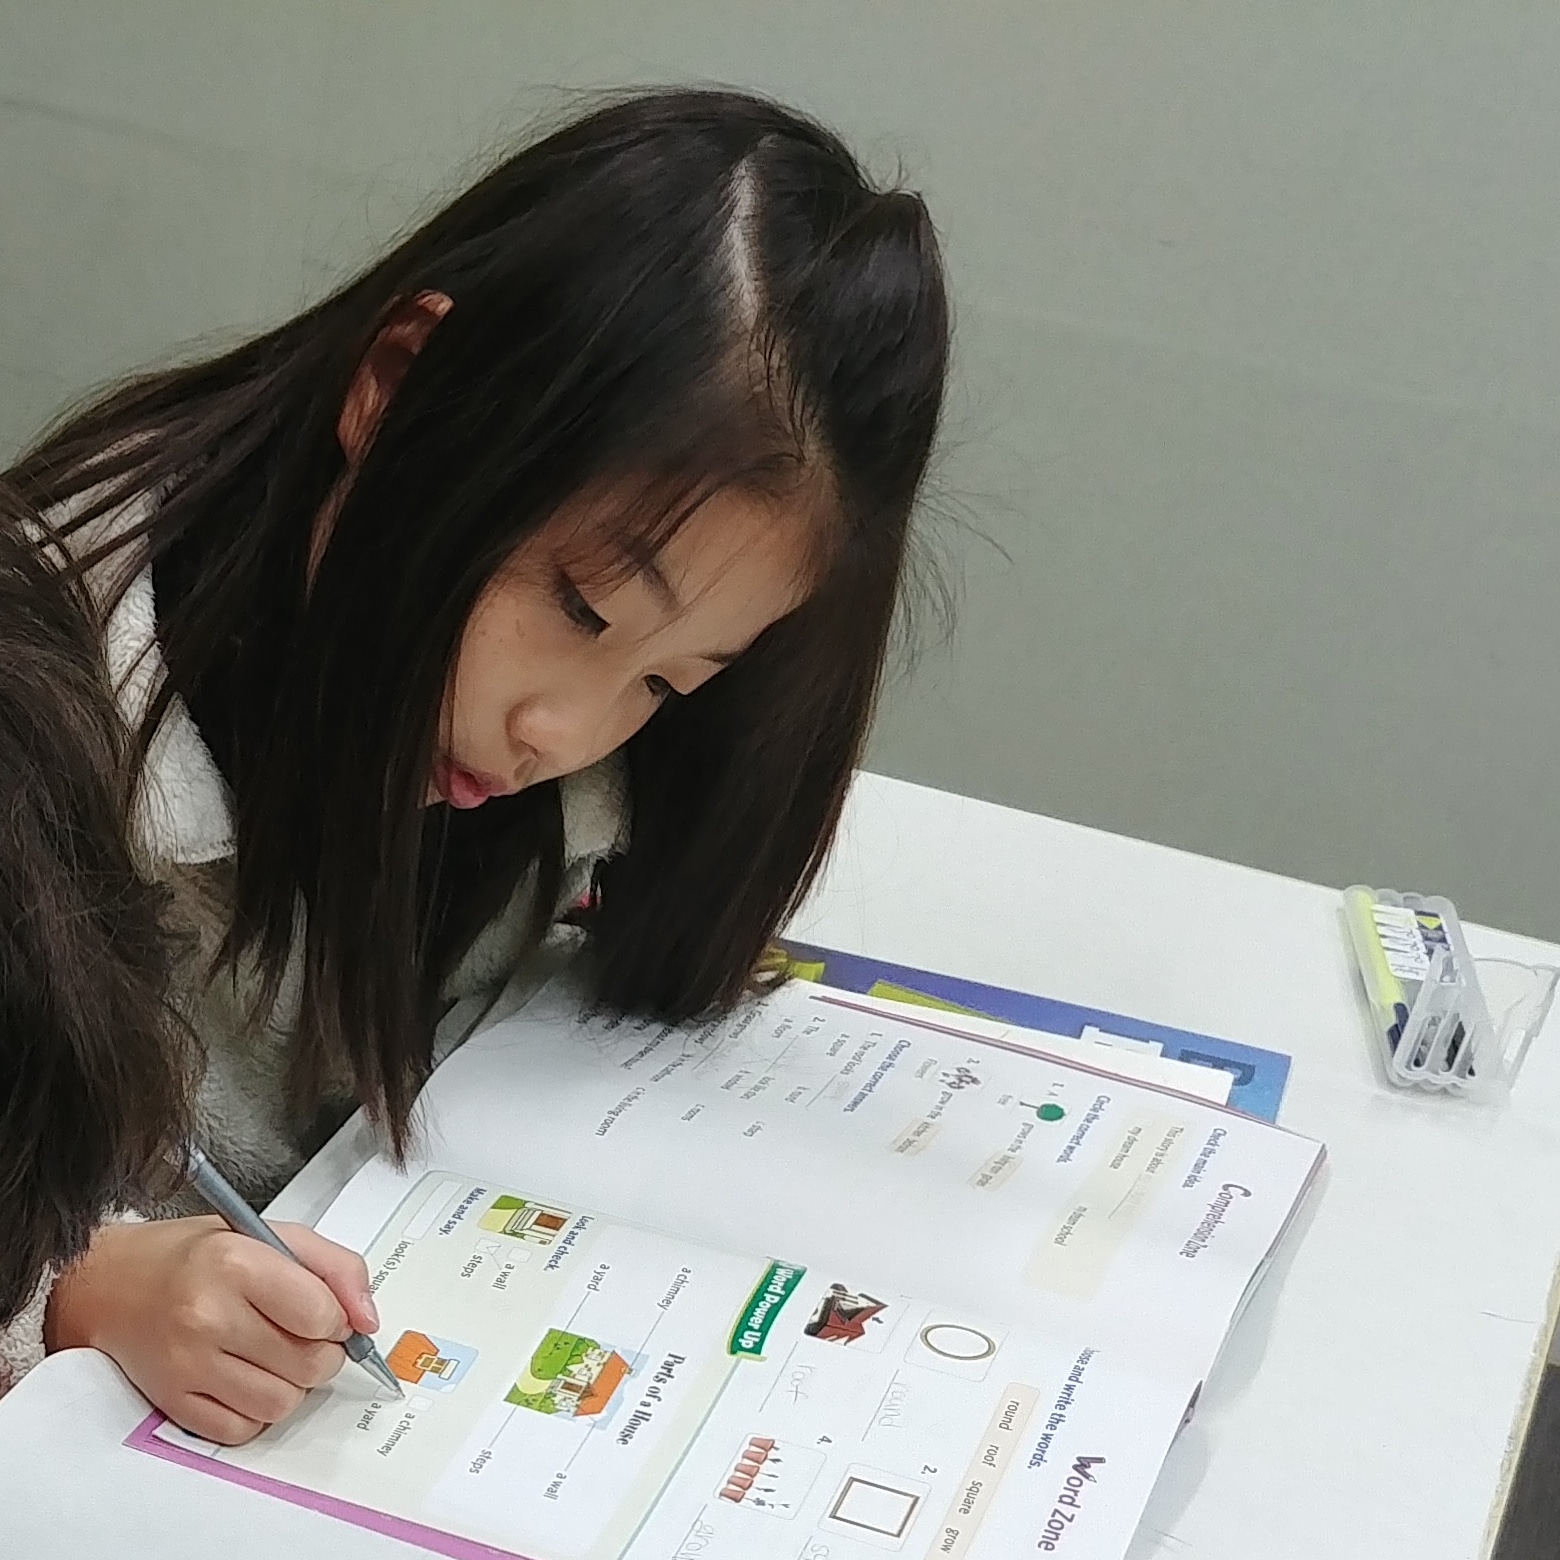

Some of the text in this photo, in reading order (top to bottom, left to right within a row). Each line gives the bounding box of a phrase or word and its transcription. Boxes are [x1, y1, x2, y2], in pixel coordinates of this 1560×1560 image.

[1206, 1128, 1228, 1147] Check
[1191, 1158, 1208, 1174] main
[1199, 1146, 1216, 1158] the
[438, 1186, 487, 1236] Make and say.
[572, 1215, 595, 1231] Look
[1192, 1183, 1252, 1244] Comprehension
[562, 1230, 578, 1246] and
[383, 1240, 411, 1271] look(s)
[461, 1254, 483, 1278] steps
[492, 1270, 511, 1290] wall
[586, 1270, 607, 1292] yard
[657, 1273, 690, 1311] chimney
[738, 1267, 795, 1349] Word Power Up
[616, 1352, 688, 1446] Parts of a House
[357, 1402, 382, 1431] a yard
[998, 1400, 1020, 1431] round
[1027, 1364, 1085, 1470] and write the words.
[376, 1412, 416, 1457] a chimney
[817, 1435, 833, 1446] 4.
[469, 1448, 492, 1475] steps
[920, 1464, 938, 1475] 2.
[981, 1444, 1000, 1469] roof
[543, 1472, 567, 1501] a wall
[957, 1480, 983, 1516] square
[1037, 1454, 1106, 1552] Word Zone
[940, 1526, 960, 1554] grow
